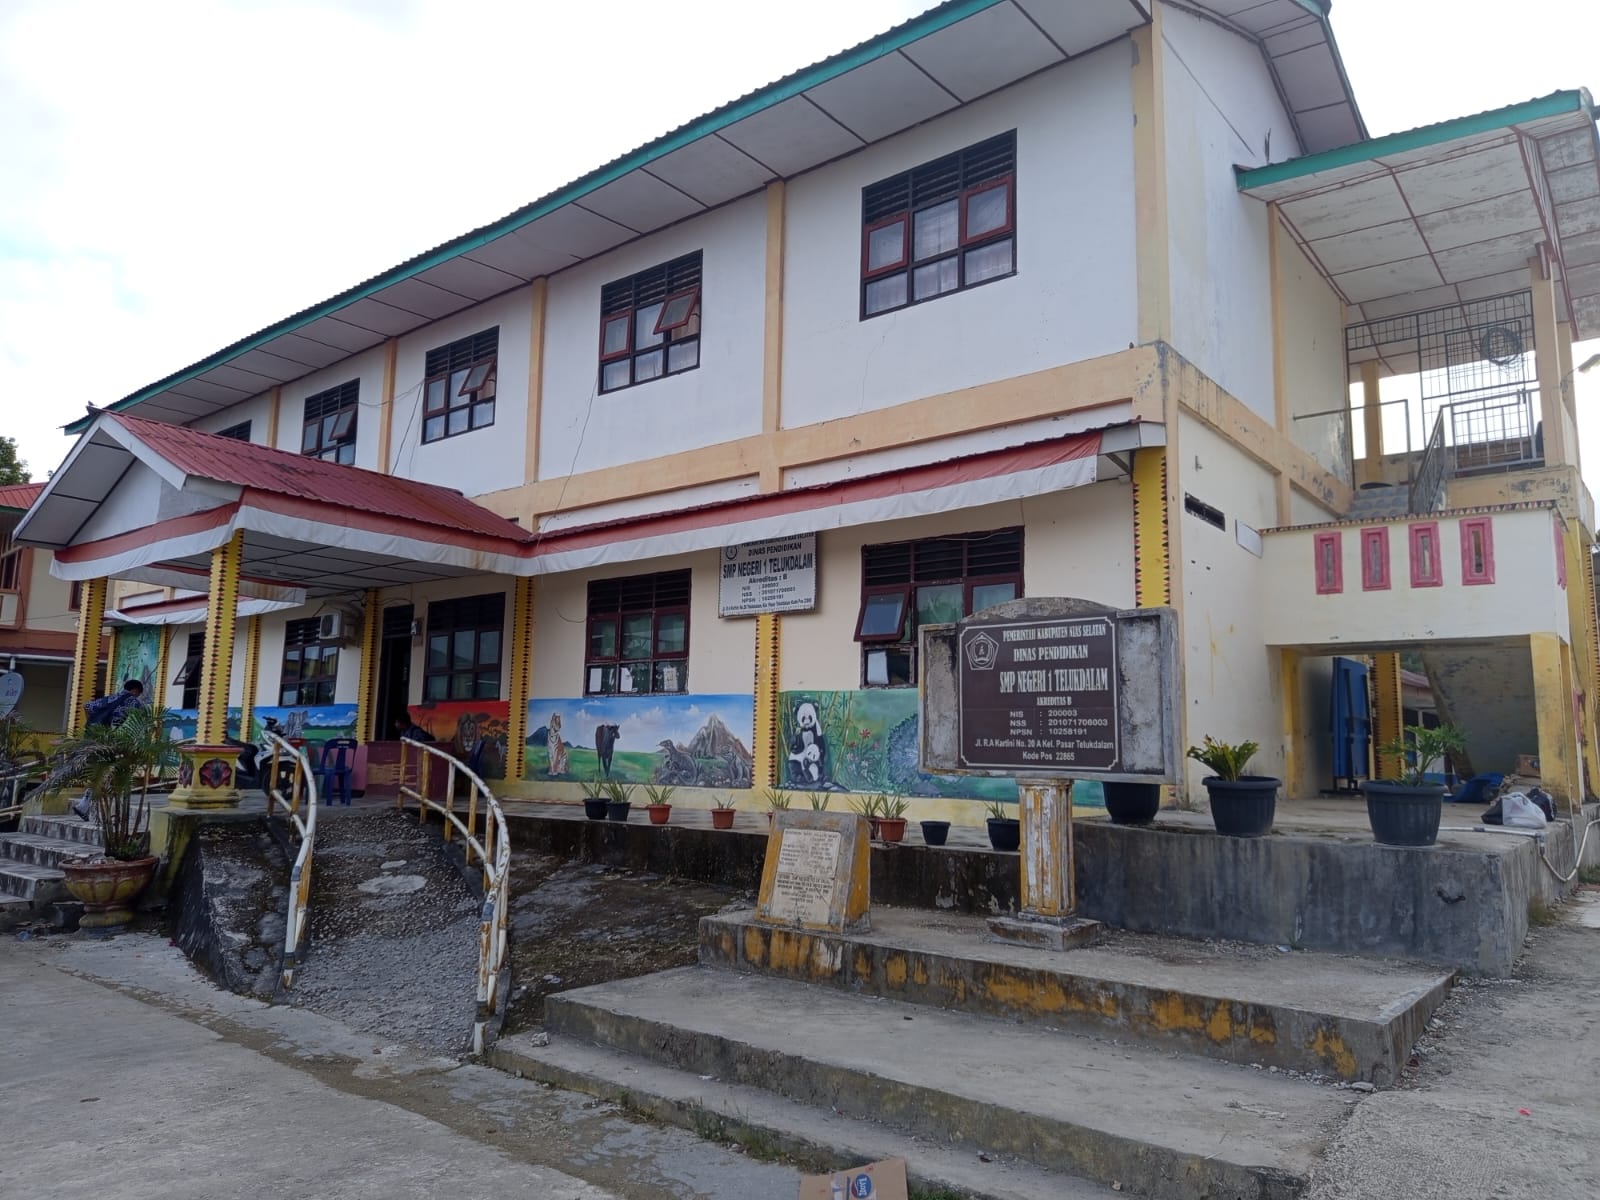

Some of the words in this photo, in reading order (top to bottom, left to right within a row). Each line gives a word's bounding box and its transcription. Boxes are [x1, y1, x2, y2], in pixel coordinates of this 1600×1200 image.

[766, 542, 802, 554] PENDIDIKAN
[723, 563, 737, 579] SMP
[738, 559, 762, 577] NEGERI
[769, 554, 813, 573] TELUKDALAM
[1037, 626, 1068, 640] KABUPATEN
[1082, 624, 1106, 637] SELATAN
[1014, 647, 1036, 662] DINAS
[1038, 645, 1088, 660] PENDIDIKAN
[999, 671, 1016, 693] SMP
[1017, 670, 1046, 692] NEGERI
[1048, 669, 1053, 692] 1
[1054, 668, 1109, 691] TELUKDALAM
[1010, 728, 1033, 736] NPSN
[995, 739, 1015, 747] Kartini
[1056, 740, 1075, 748] Pasar
[1077, 740, 1114, 749] Telukdalam
[1023, 751, 1039, 760] Kode
[1041, 752, 1052, 760] Pos
